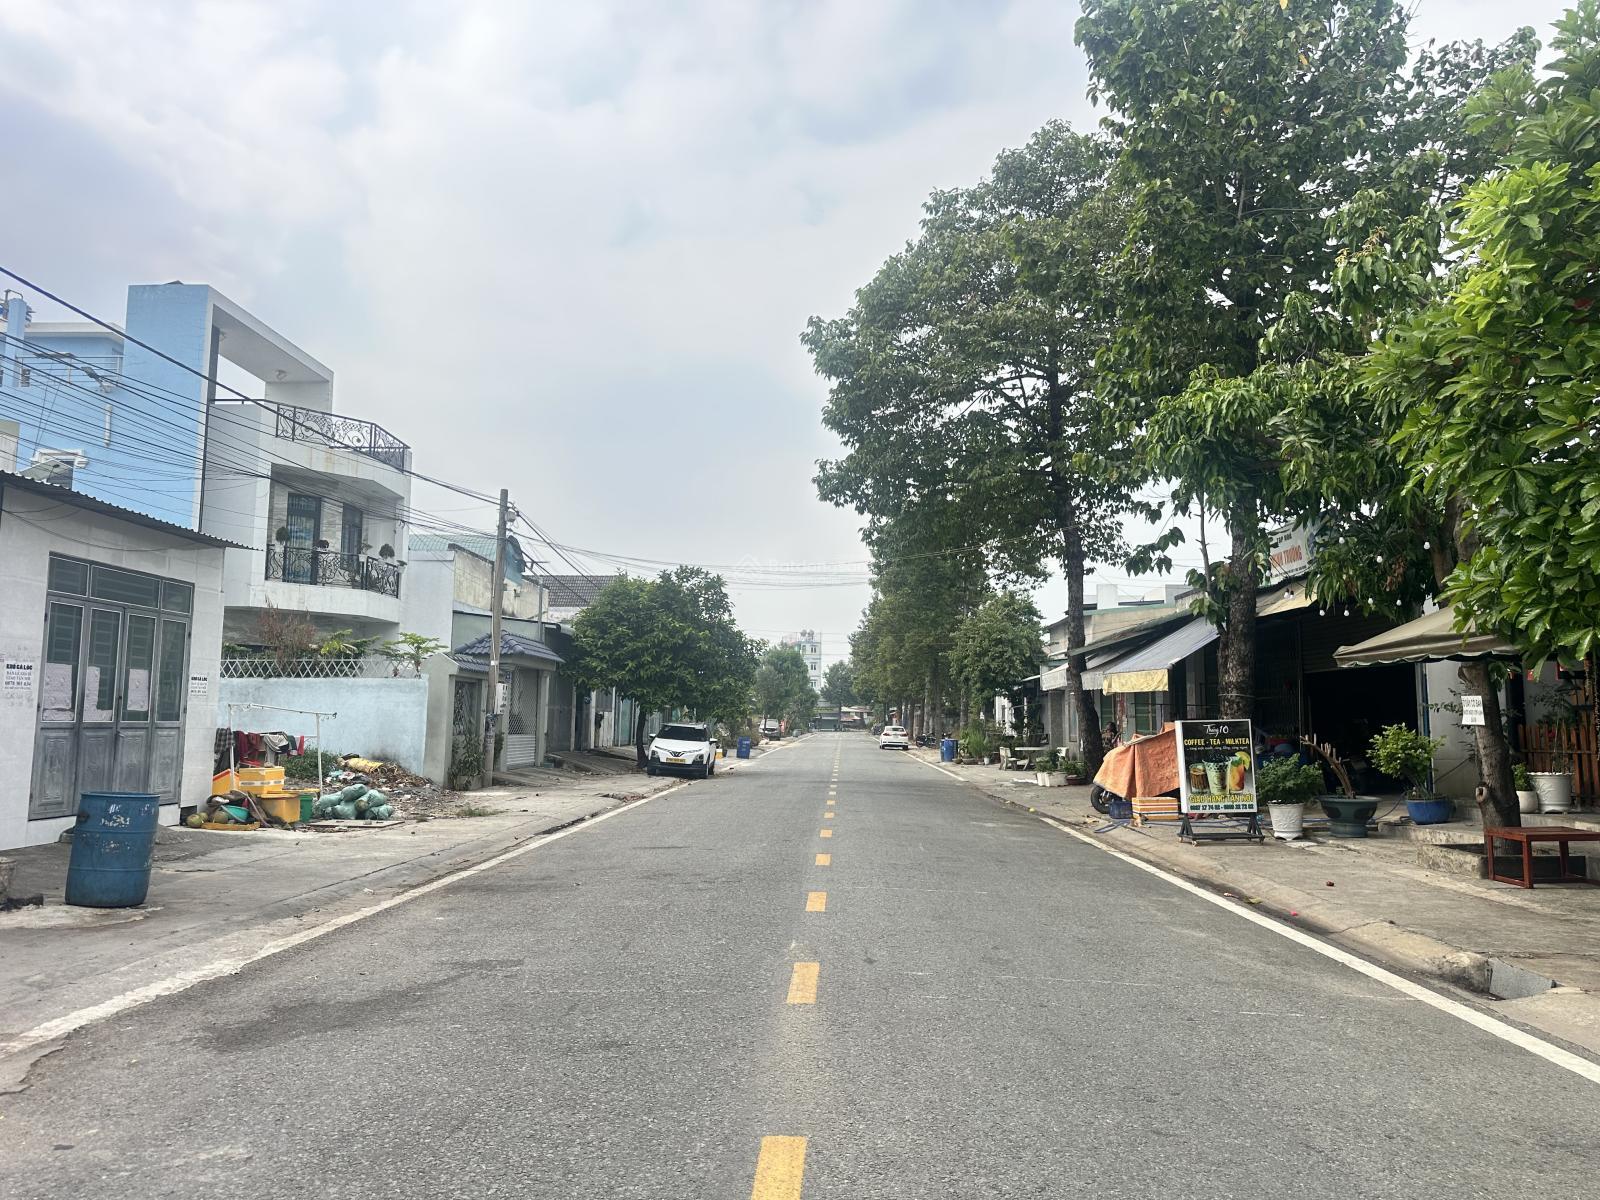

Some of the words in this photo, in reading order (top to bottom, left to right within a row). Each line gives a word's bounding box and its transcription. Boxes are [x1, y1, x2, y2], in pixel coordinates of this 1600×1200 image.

[1219, 725, 1229, 734] 10
[1184, 738, 1205, 746] COFFEE
[1225, 737, 1250, 745] MILKTEA
[1190, 794, 1204, 803] GIAO
